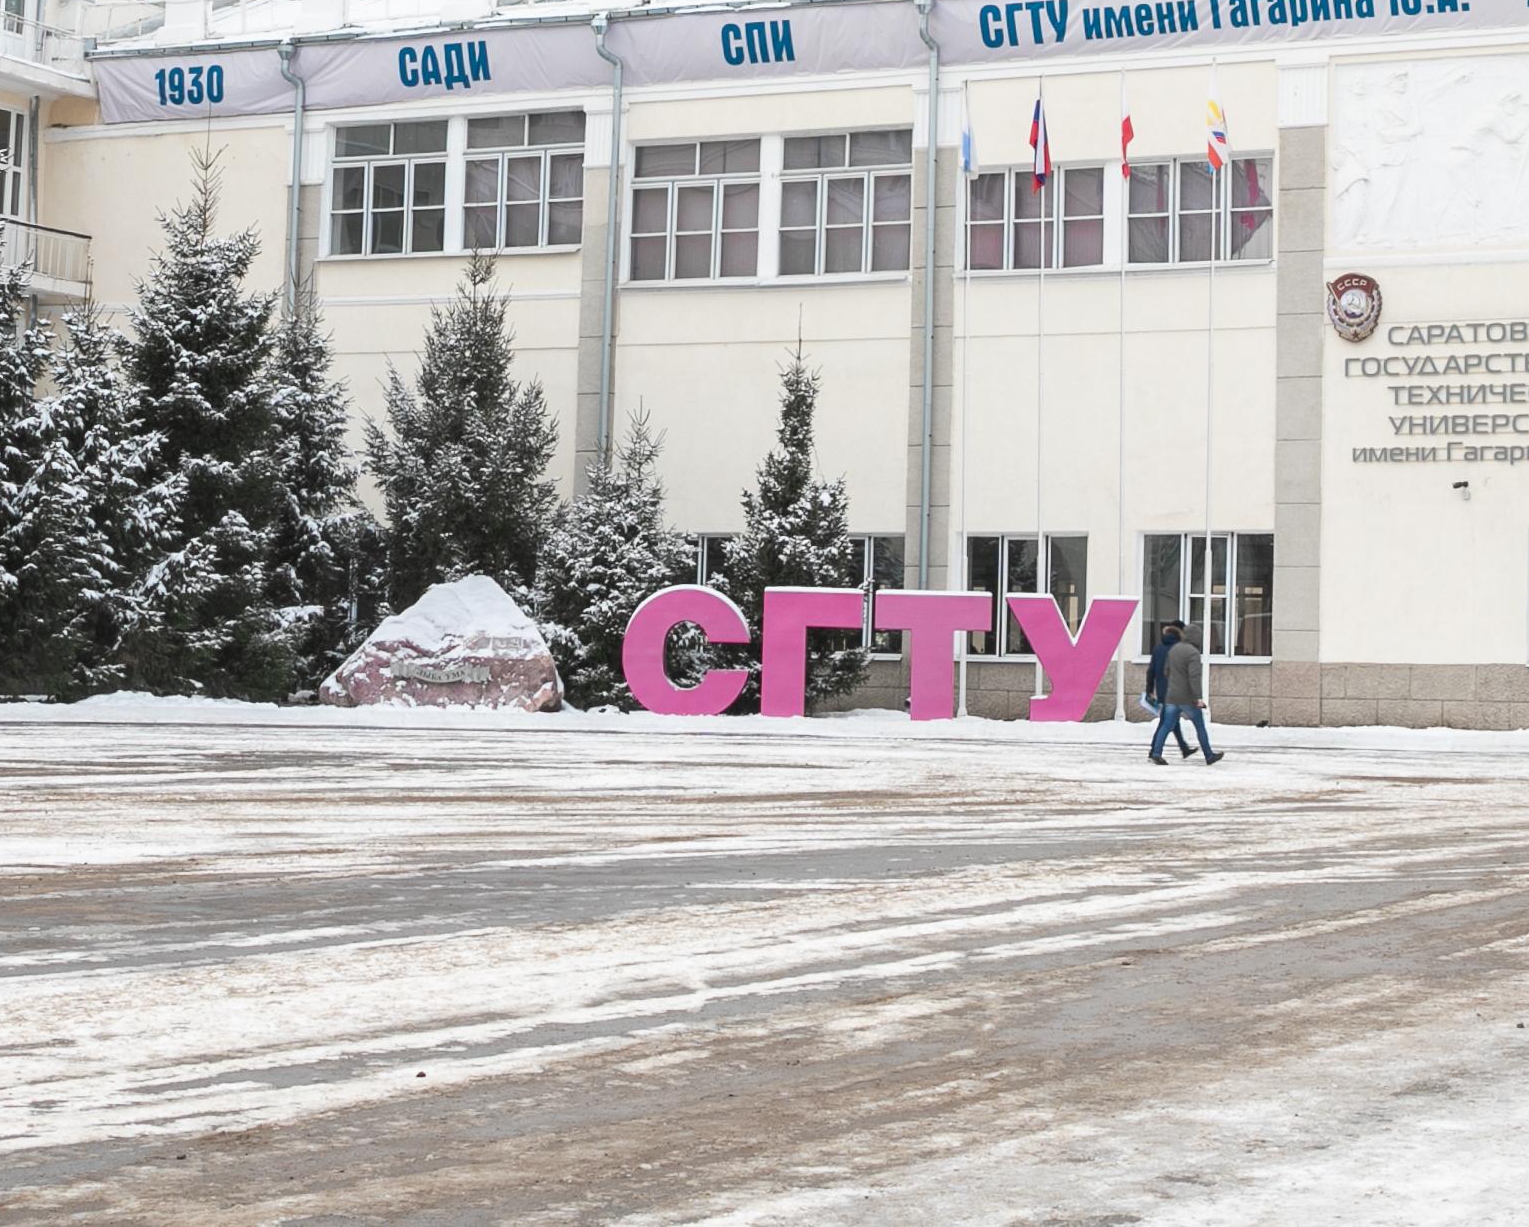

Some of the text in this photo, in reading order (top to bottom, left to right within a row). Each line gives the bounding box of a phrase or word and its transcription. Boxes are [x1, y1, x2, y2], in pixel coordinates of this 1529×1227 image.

[1082, 0, 1199, 40] имени
[721, 19, 795, 66] СПИ
[155, 64, 224, 106] 1930
[398, 40, 492, 90] САДИ
[1336, 278, 1367, 291] СССР
[1351, 446, 1438, 464] имени
[621, 584, 1139, 723] СГТУ
